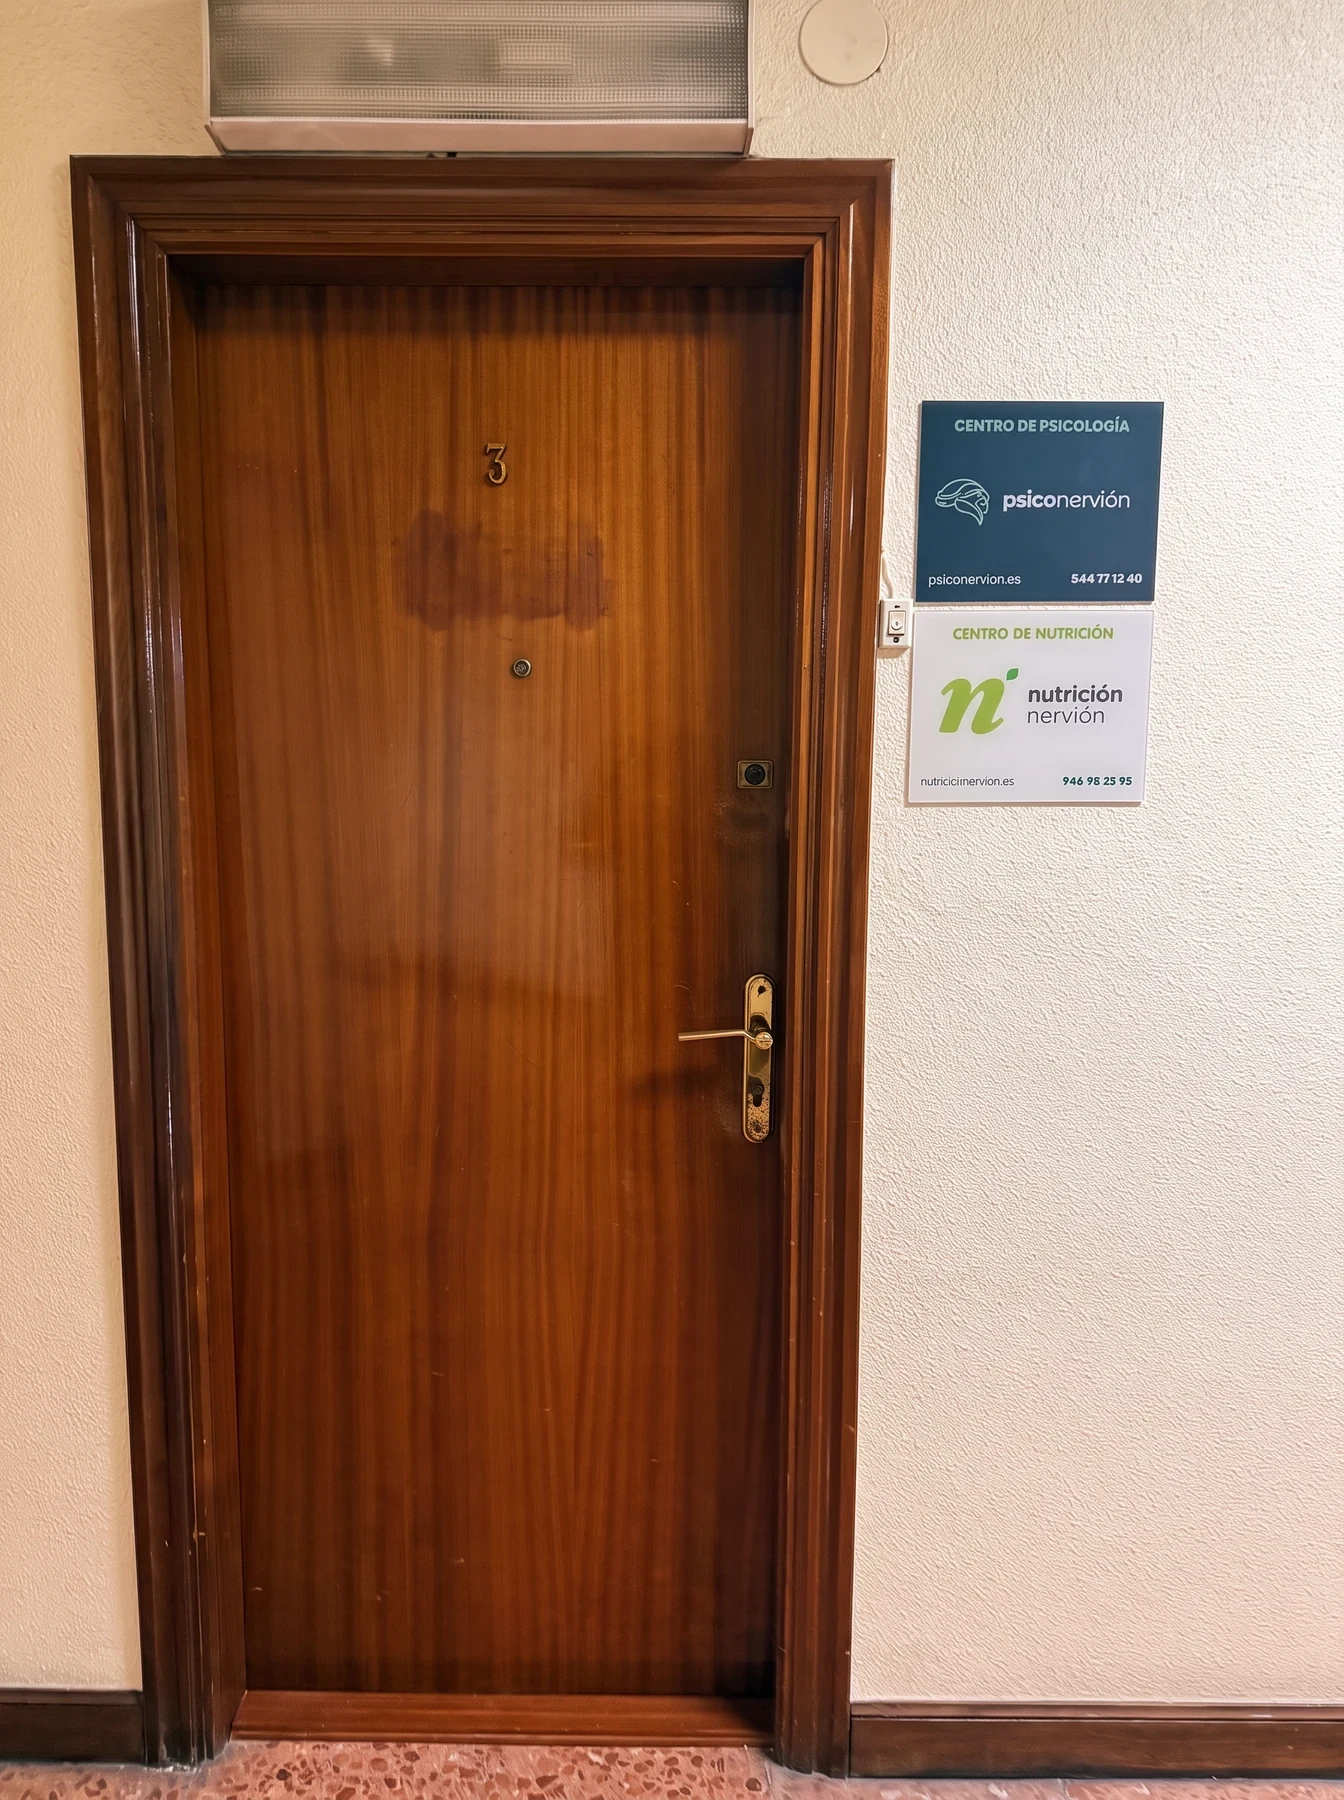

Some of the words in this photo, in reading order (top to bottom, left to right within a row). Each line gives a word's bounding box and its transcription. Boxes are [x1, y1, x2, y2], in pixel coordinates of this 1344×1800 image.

[954, 419, 1015, 432] CENTRO
[1017, 419, 1037, 432] DE
[1039, 416, 1130, 433] PSICOLOGÍA
[485, 443, 507, 484] 3
[1002, 489, 1131, 512] psiconervión
[928, 573, 1022, 588] psiconervion.es
[1070, 573, 1096, 584] 544
[1096, 573, 1111, 584] 77
[1111, 573, 1125, 584] 12
[1126, 573, 1143, 584] 40
[952, 627, 1009, 640] CENTRO
[1013, 627, 1032, 640] DE
[1035, 624, 1114, 640] NUTRICIÓN
[1028, 684, 1123, 703] nutrición
[1027, 706, 1105, 724] nervión
[1062, 776, 1084, 786] 946
[1087, 776, 1101, 786] 98
[1103, 776, 1117, 786] 25
[1119, 776, 1133, 786] 95
